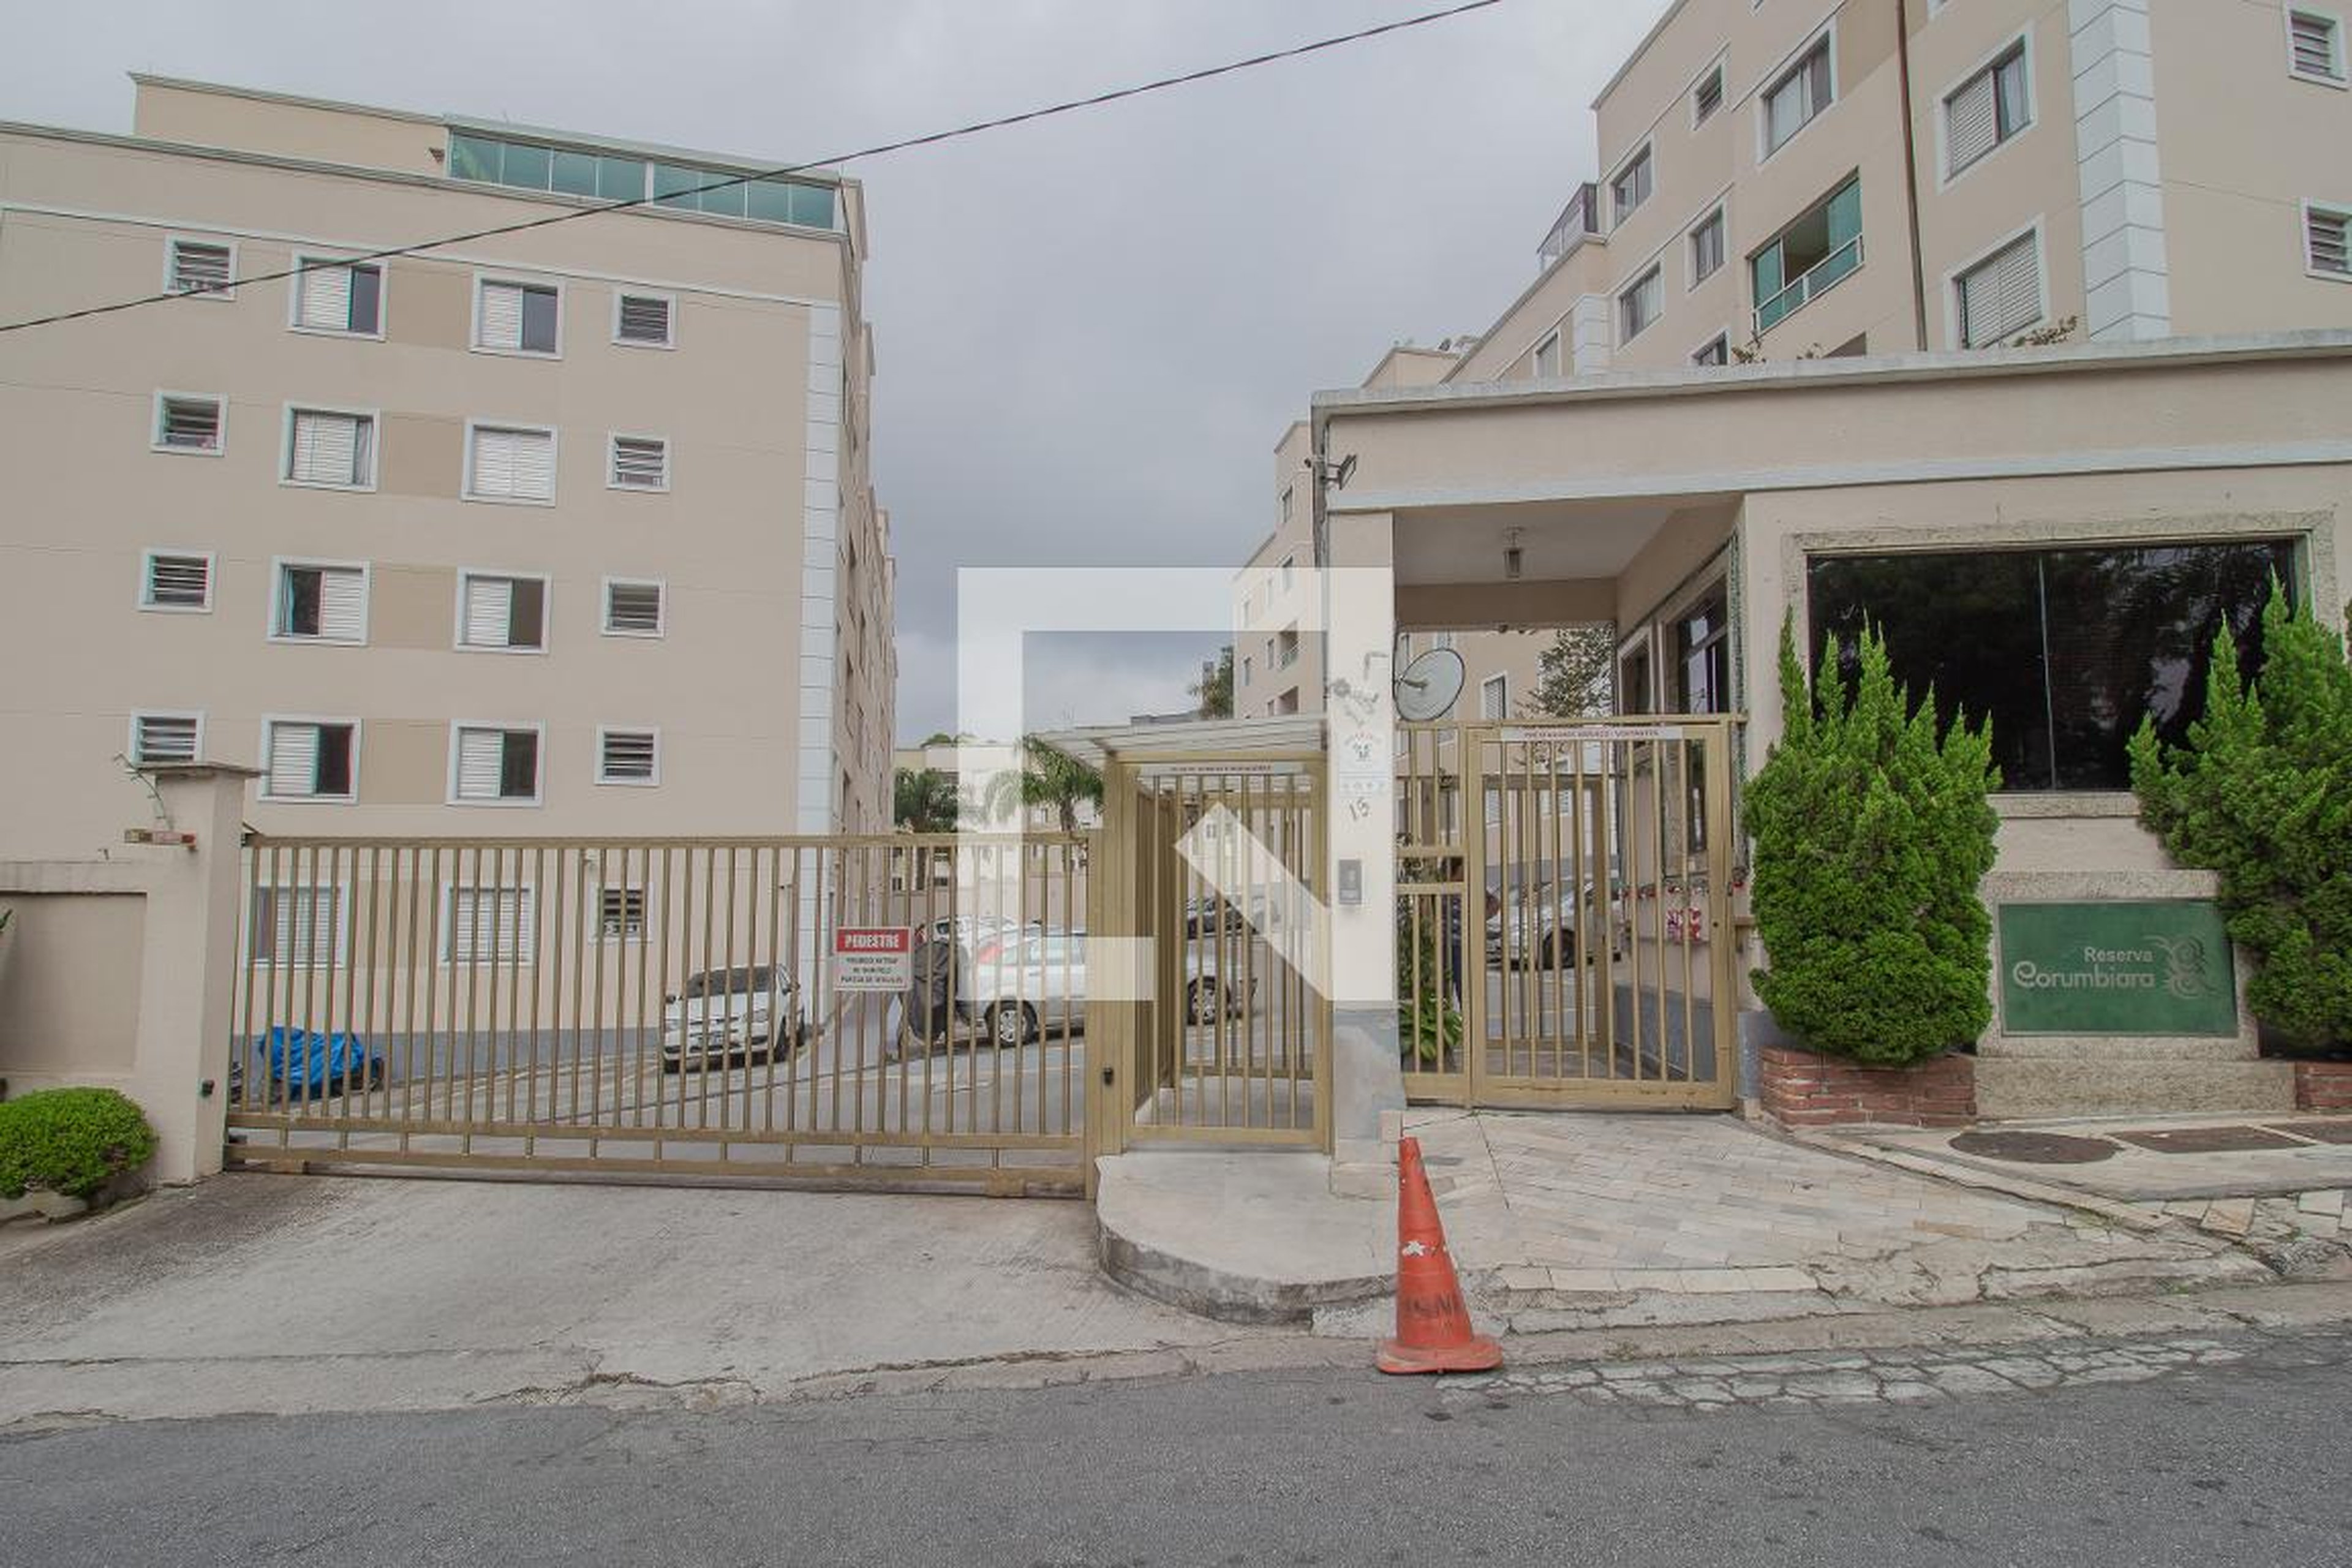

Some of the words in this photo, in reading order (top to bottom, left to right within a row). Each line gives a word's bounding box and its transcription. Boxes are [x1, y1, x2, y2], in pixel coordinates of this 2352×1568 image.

[844, 934, 900, 949] PEDESTRE
[2084, 946, 2154, 962] Reserva
[2013, 960, 2156, 988] Corumbiara
